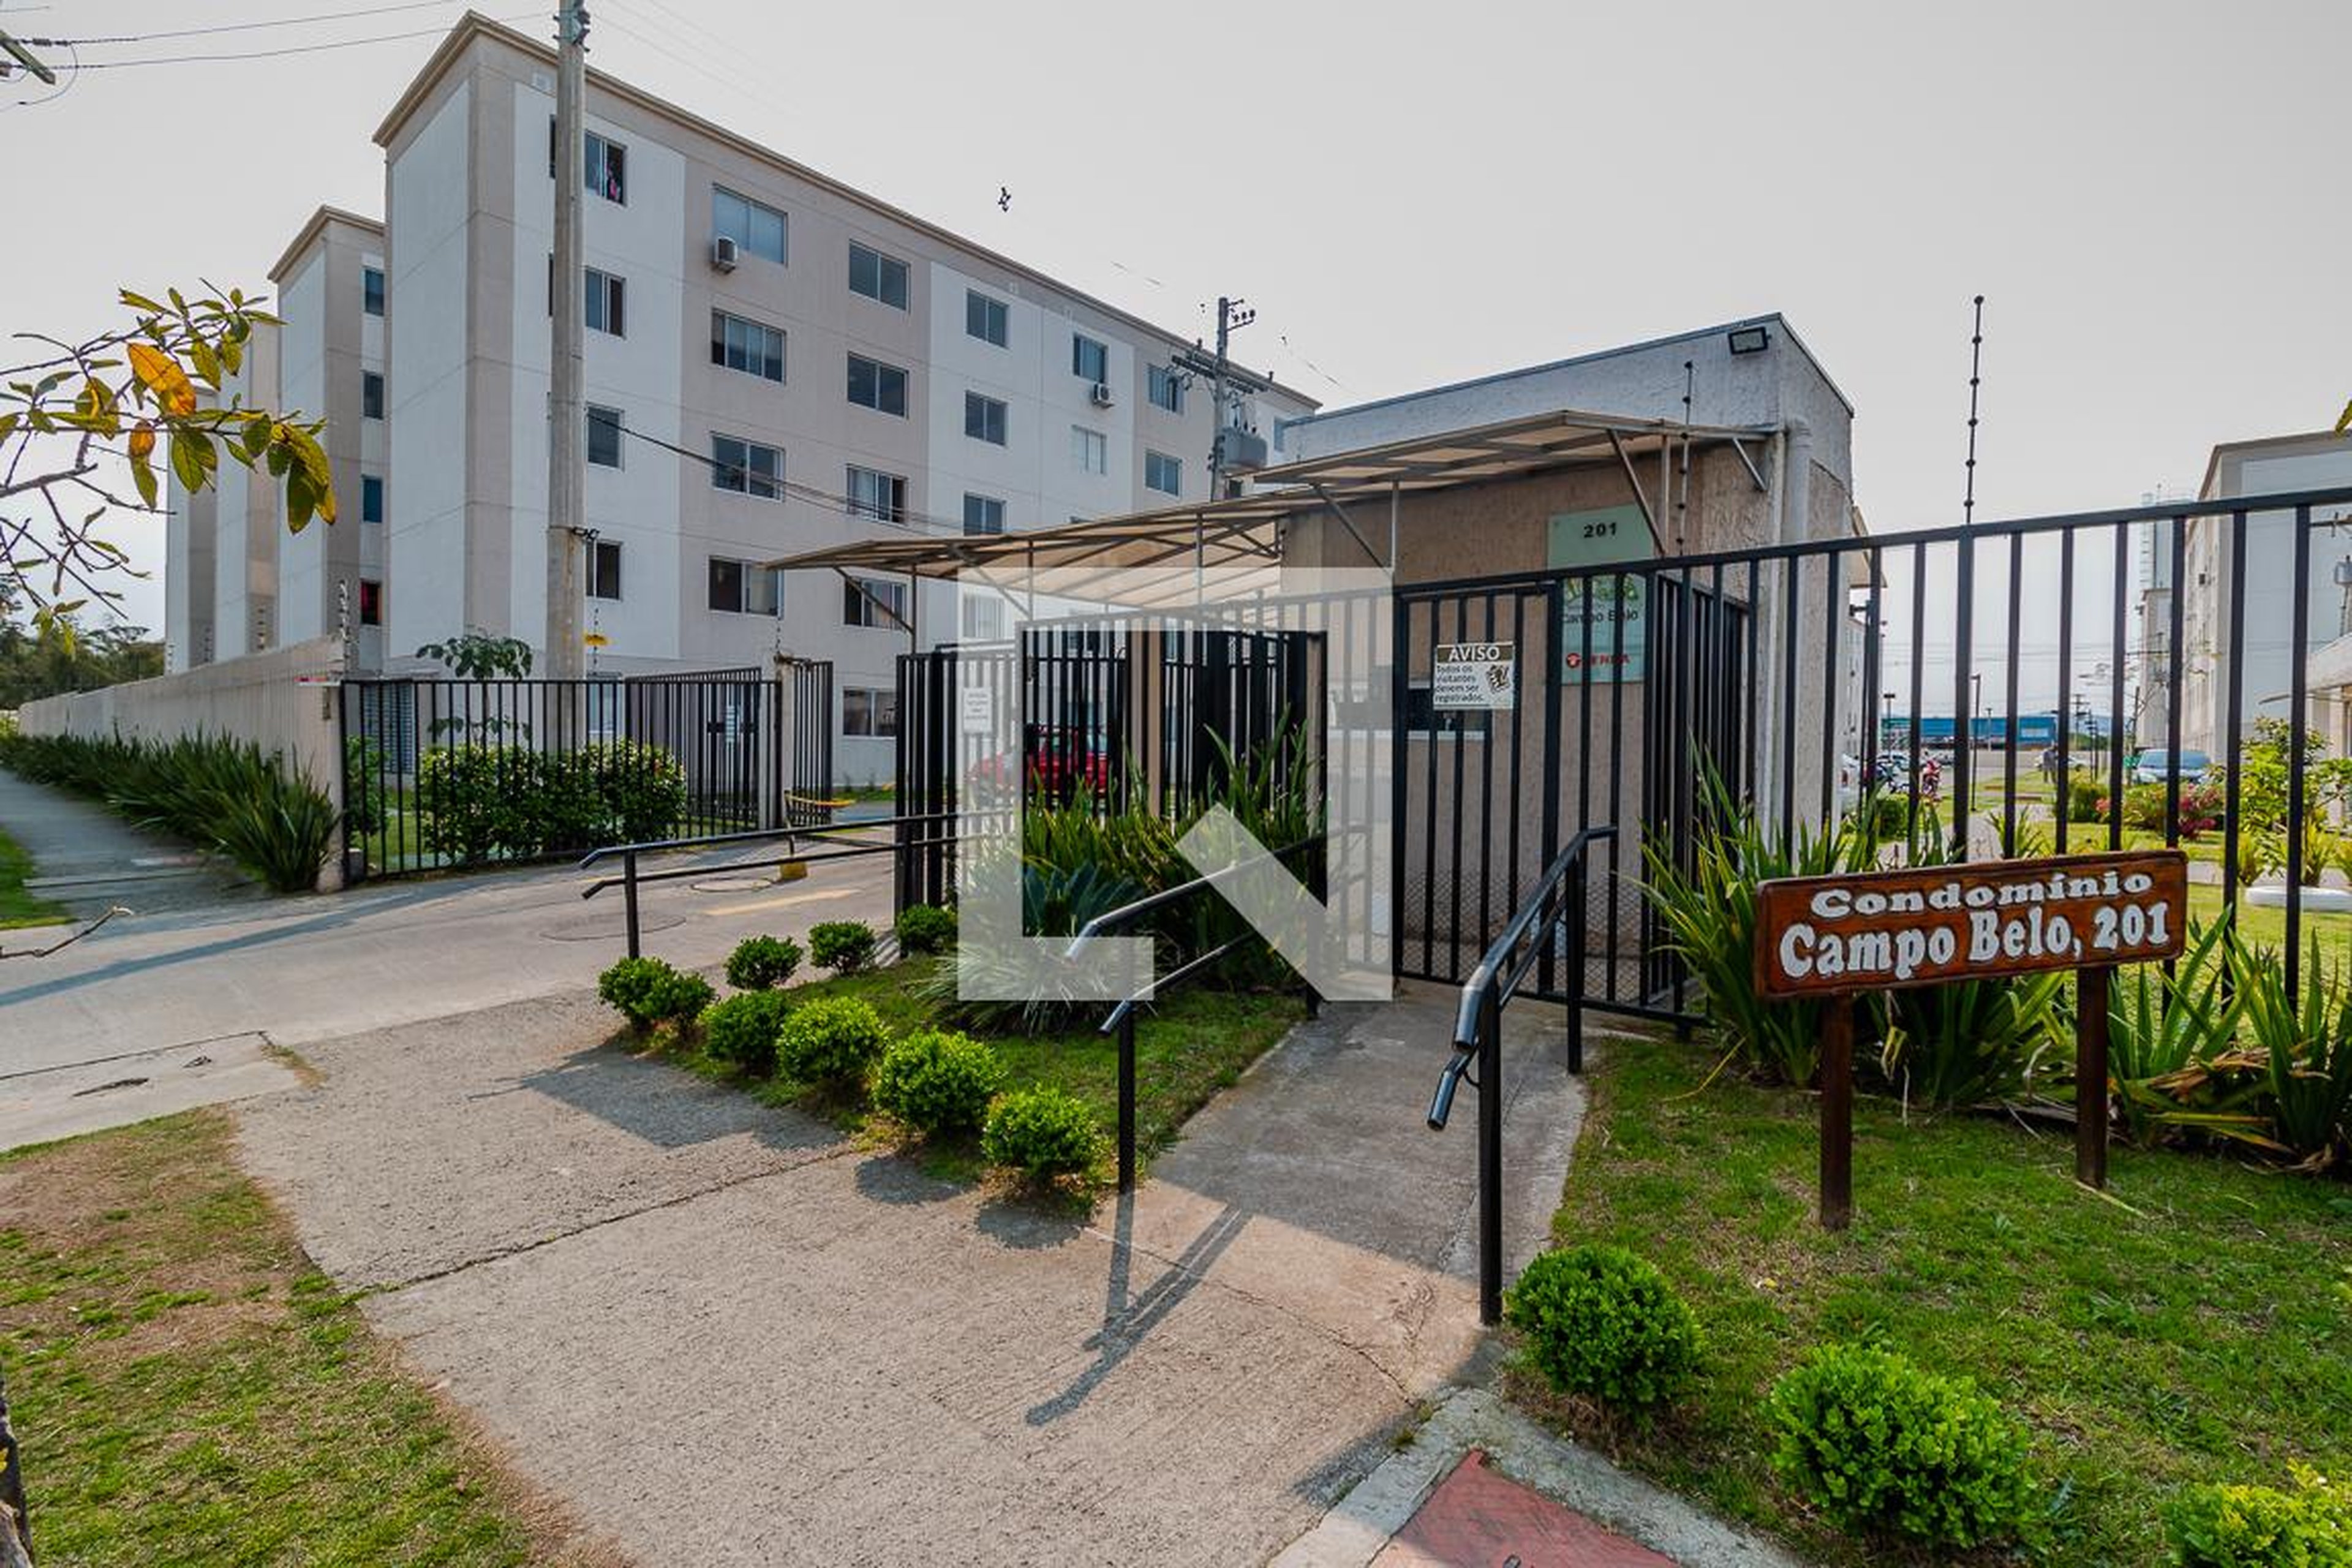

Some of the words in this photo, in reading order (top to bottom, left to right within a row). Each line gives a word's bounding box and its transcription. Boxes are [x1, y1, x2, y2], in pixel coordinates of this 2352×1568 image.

[1584, 522, 1616, 538] 201
[1561, 612, 1604, 624] Camo
[1609, 608, 1638, 621] Blo
[1448, 646, 1500, 662] AVISO
[1779, 923, 1956, 980] Campo
[1969, 905, 2082, 962] Belo,
[2093, 901, 2170, 951] 201
